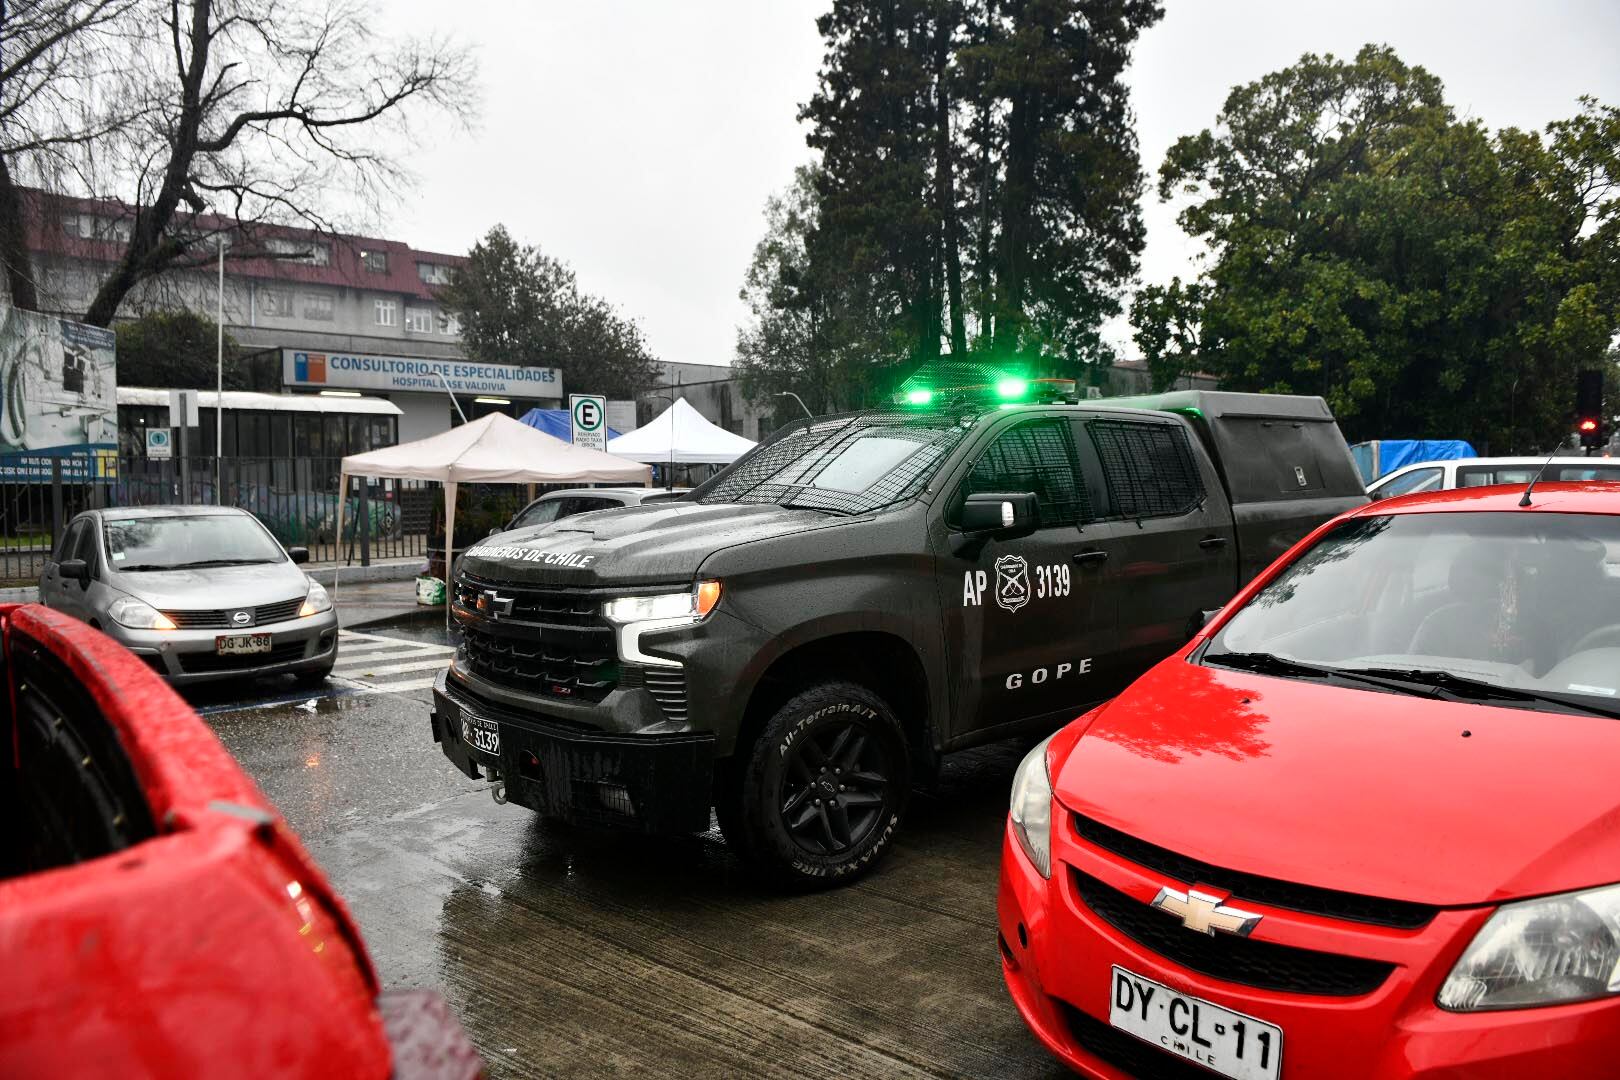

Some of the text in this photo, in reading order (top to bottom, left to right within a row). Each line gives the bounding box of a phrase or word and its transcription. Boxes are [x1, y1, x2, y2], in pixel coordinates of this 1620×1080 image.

[331, 357, 429, 374] CONSULTORIO
[433, 364, 450, 377] DE
[454, 365, 555, 383] ESPECIALIDADES
[393, 377, 506, 391] HOSPITAL BASE VALDIVIA
[583, 405, 595, 425] E
[523, 549, 545, 562] DE
[545, 552, 594, 568] CHILE
[963, 564, 1070, 606] AP 3139
[1006, 658, 1092, 690] GOPE
[1161, 1035, 1216, 1066] CHILE
